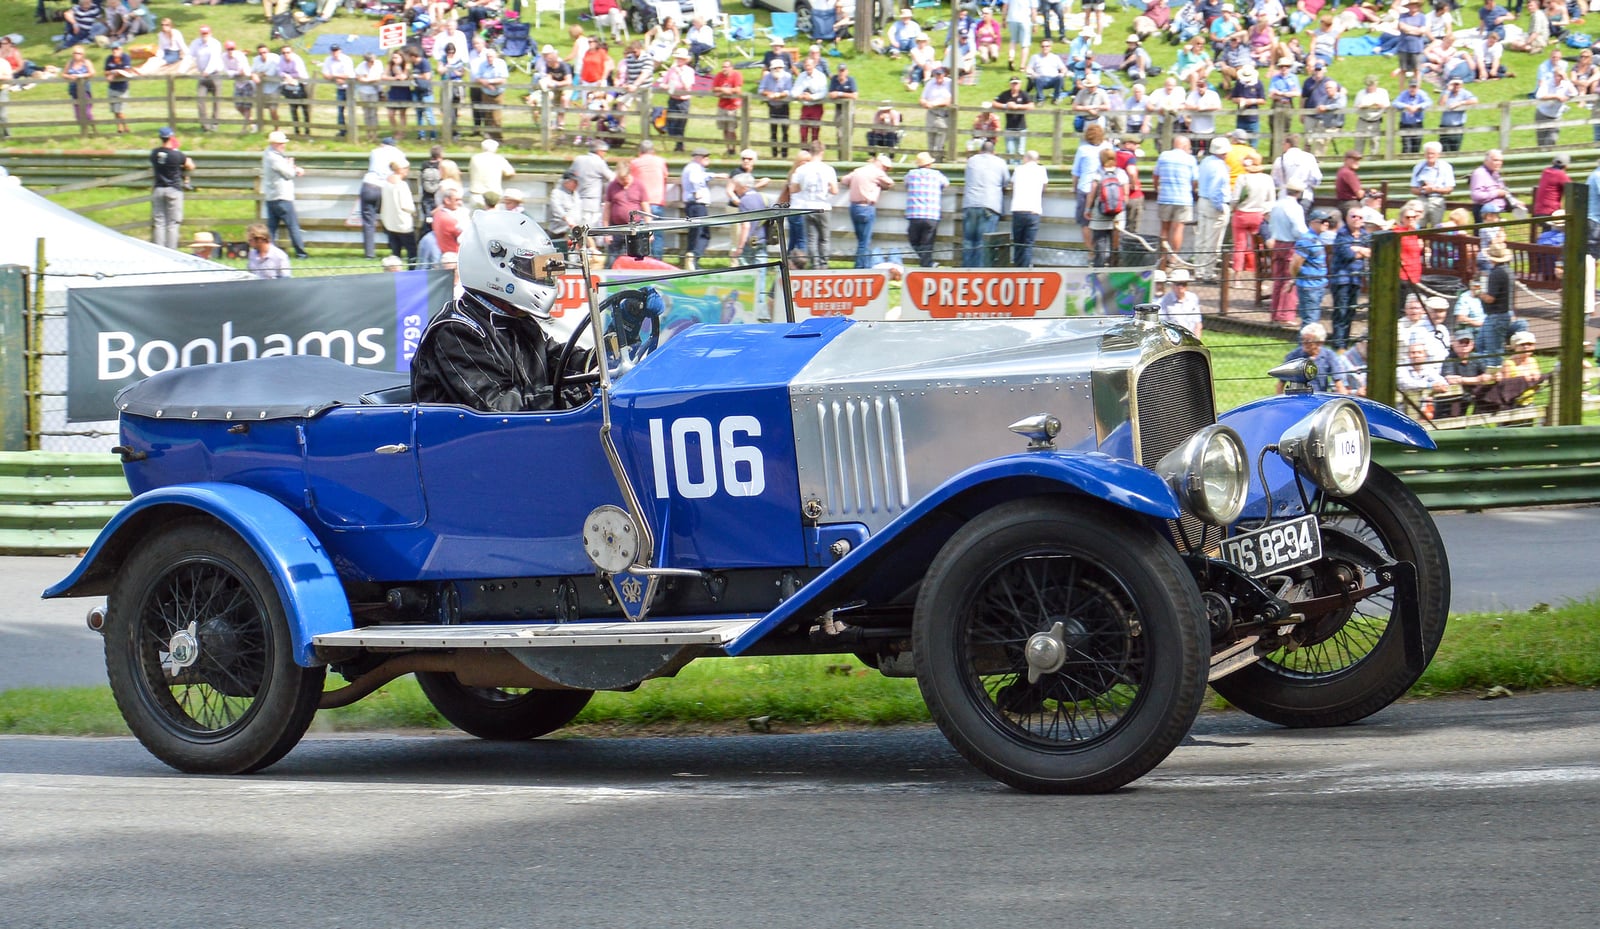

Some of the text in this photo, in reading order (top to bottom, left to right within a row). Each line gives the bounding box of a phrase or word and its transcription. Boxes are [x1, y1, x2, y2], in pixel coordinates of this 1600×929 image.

[791, 278, 874, 299] PRESCOTT
[921, 277, 1045, 307] PRESCOTT
[97, 320, 387, 381] Bonhams
[403, 314, 421, 361] 1793
[649, 415, 766, 499] 106
[1341, 440, 1356, 456] 106
[1228, 521, 1313, 573] DS 8294
